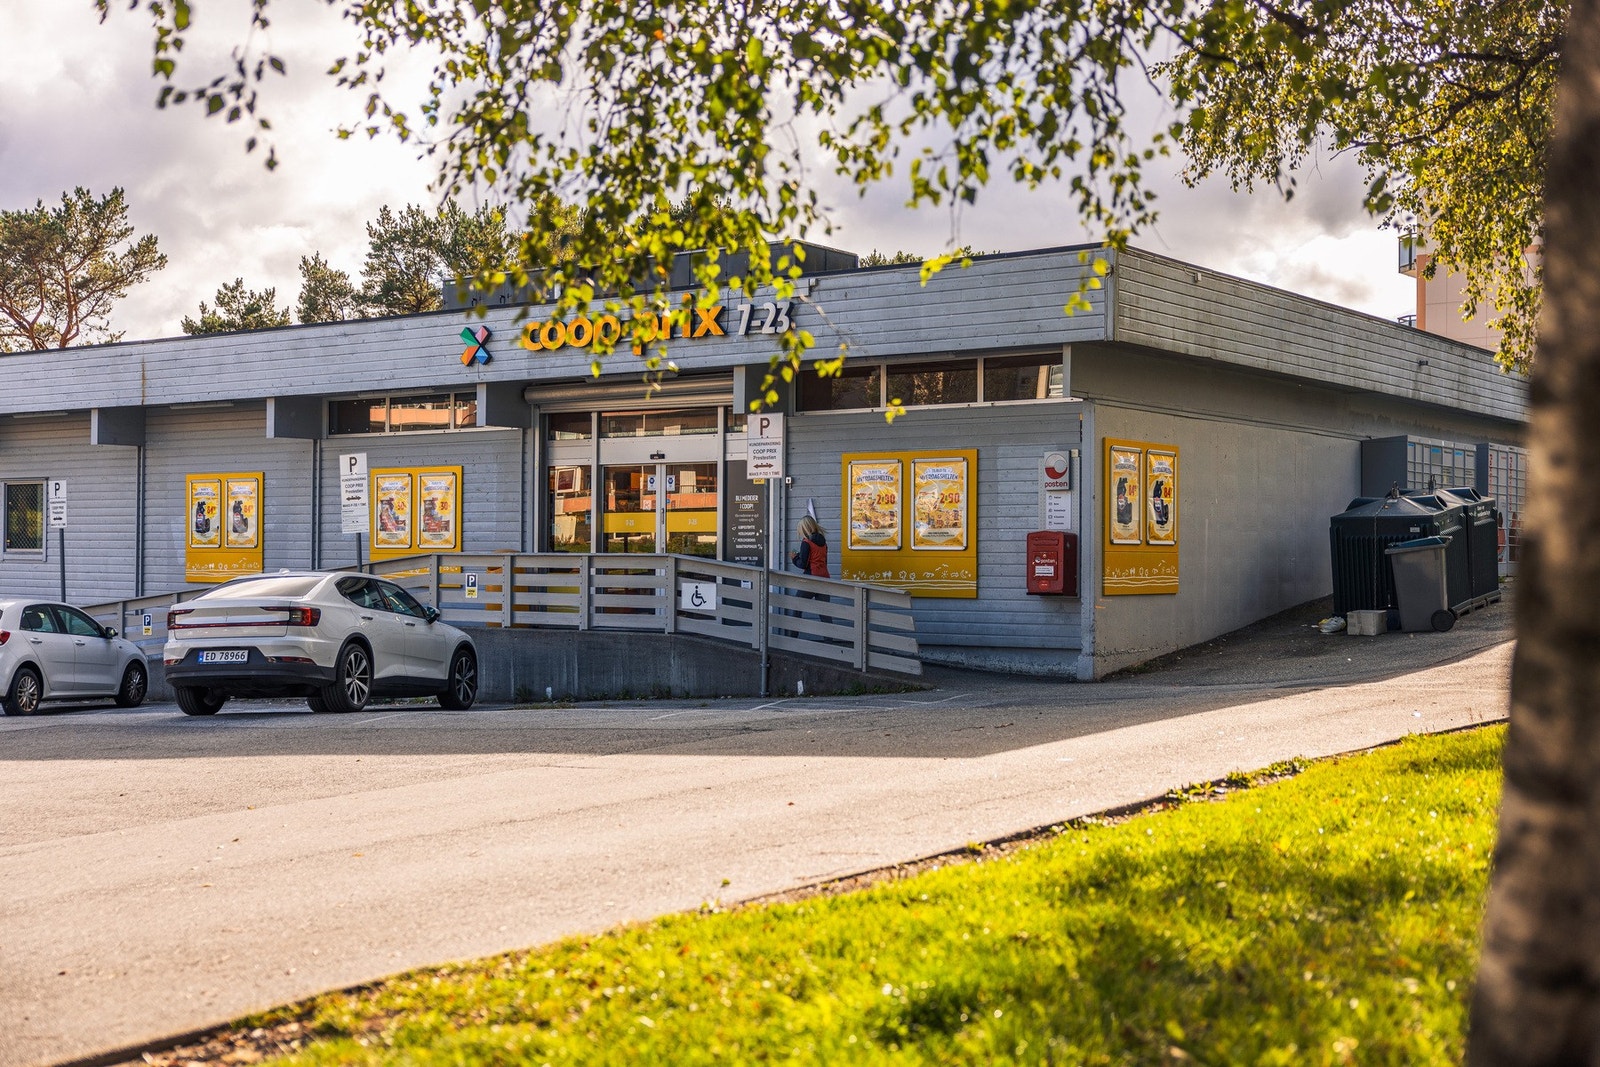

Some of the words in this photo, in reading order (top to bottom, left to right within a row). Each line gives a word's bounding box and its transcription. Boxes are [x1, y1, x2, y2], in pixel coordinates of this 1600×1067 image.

[521, 314, 621, 353] coop
[737, 301, 792, 336] 7-23
[760, 417, 770, 436] P
[349, 456, 358, 472] P
[55, 482, 60, 496] P
[469, 576, 474, 586] P
[145, 616, 150, 625] P
[205, 652, 216, 660] ED
[220, 652, 246, 660] 78966
